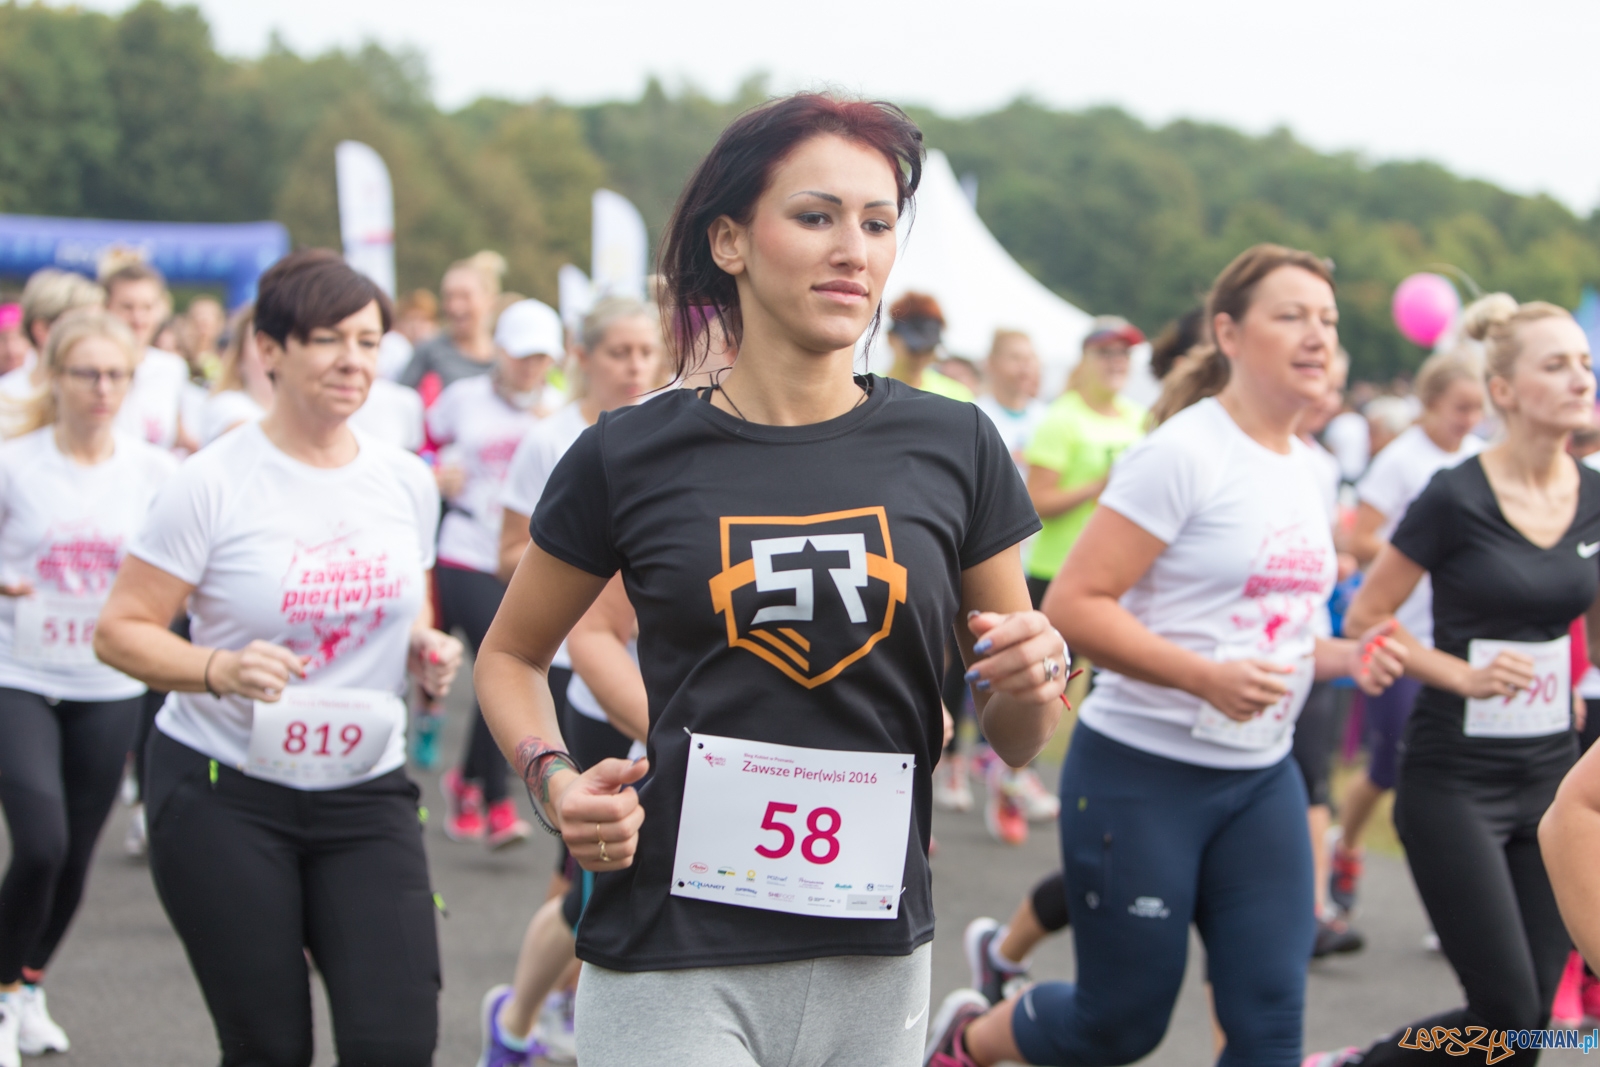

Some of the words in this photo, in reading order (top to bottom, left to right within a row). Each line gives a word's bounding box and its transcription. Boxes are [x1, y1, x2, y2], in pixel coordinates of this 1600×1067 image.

[751, 533, 868, 625] SR
[282, 720, 364, 758] 819
[742, 760, 790, 777] Zawsze
[793, 767, 846, 784] Pier(w)si
[848, 771, 878, 784] 2016
[754, 801, 842, 865] 58
[687, 880, 726, 891] AQUANET
